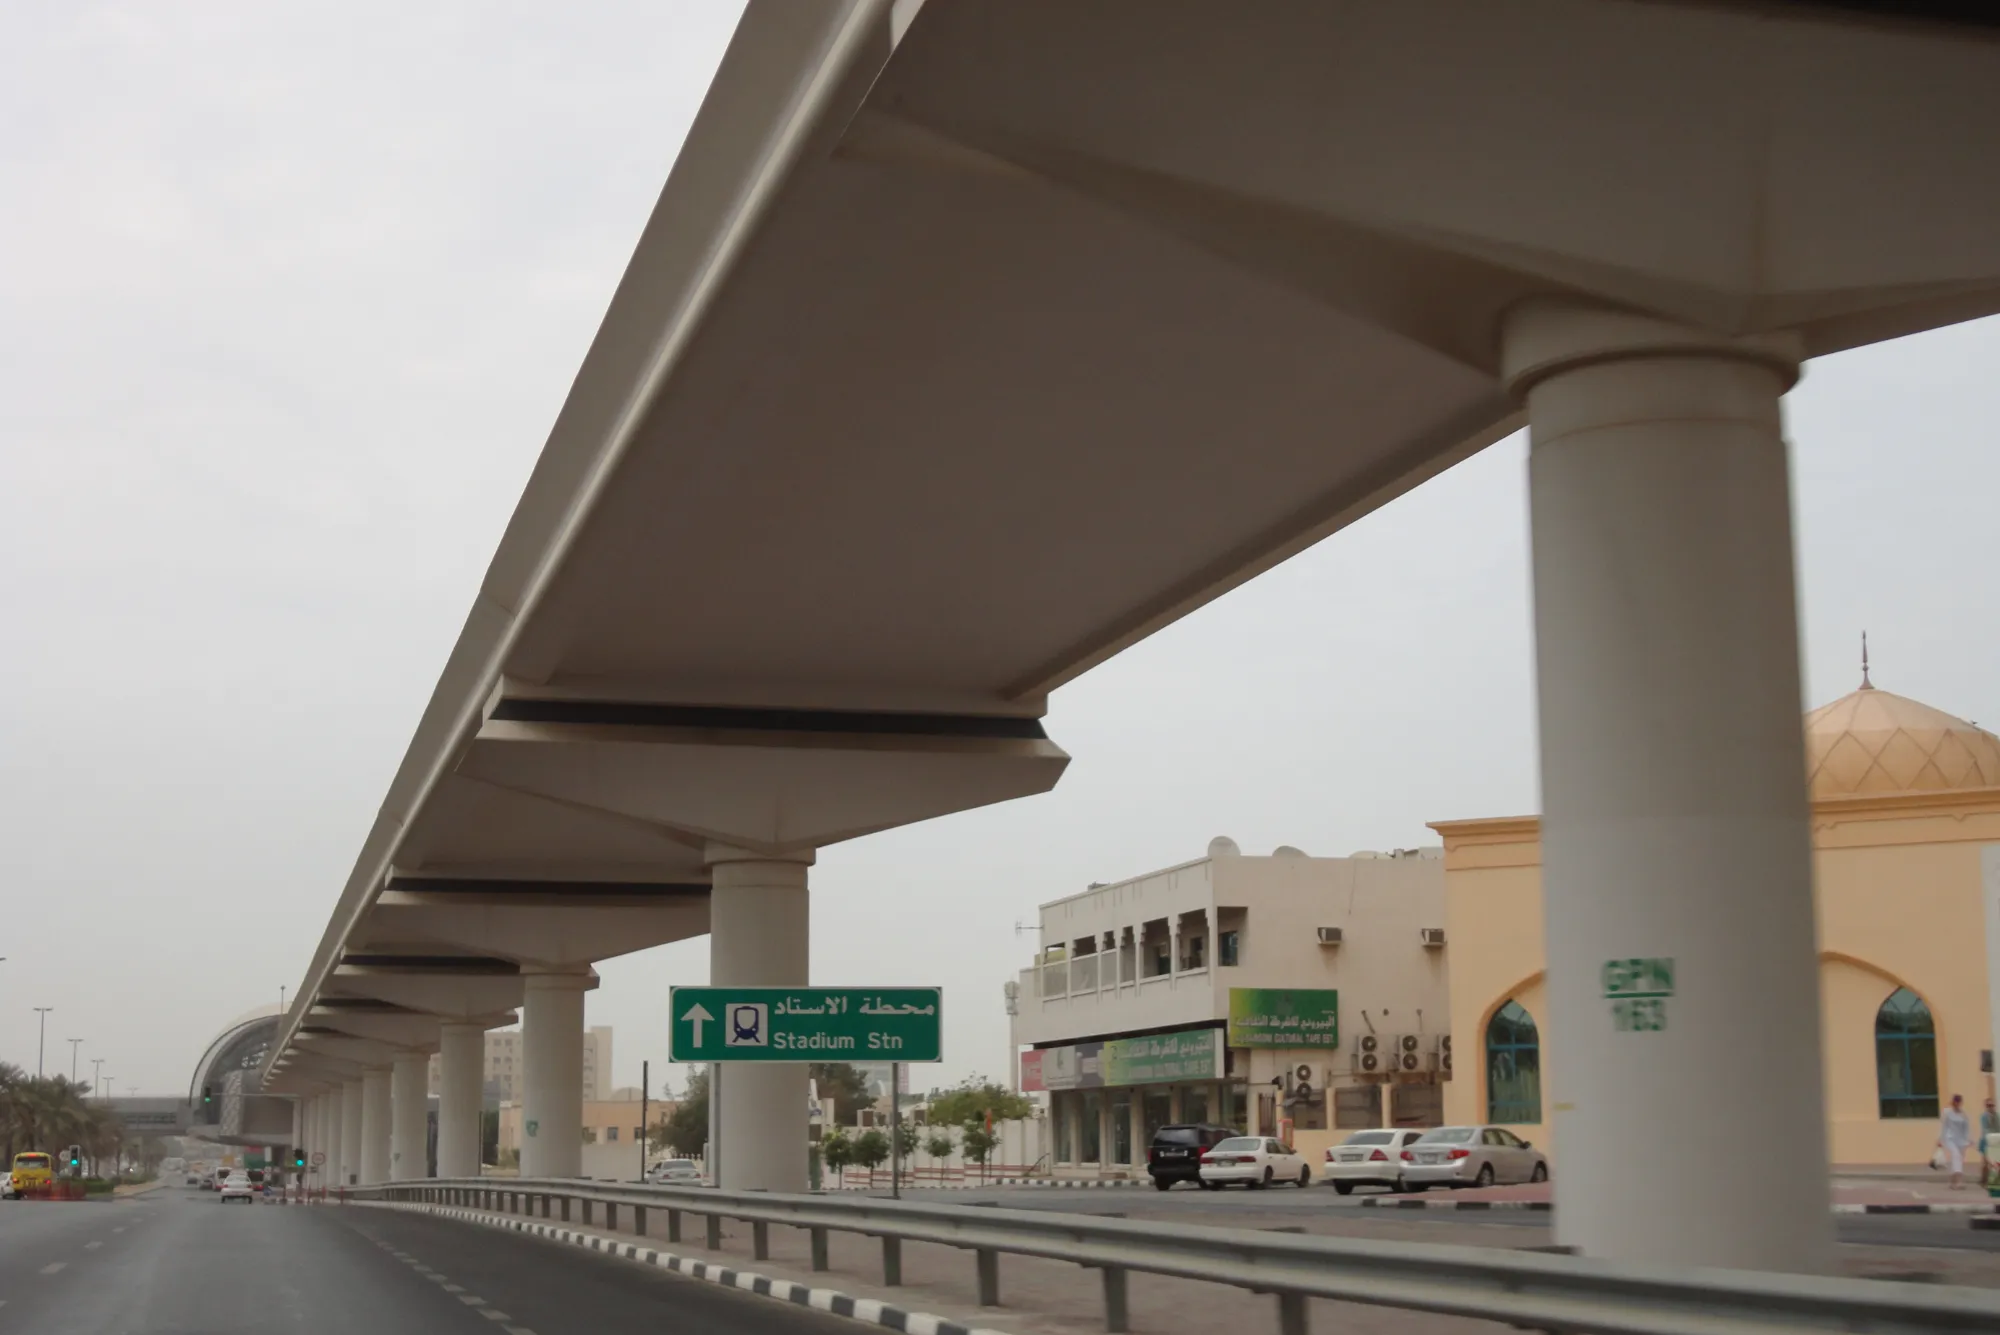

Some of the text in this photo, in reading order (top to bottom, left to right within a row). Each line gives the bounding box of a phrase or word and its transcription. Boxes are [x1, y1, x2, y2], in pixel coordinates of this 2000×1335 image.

[859, 997, 935, 1016] محطة
[773, 1032, 903, 1049] Stadium Stn
